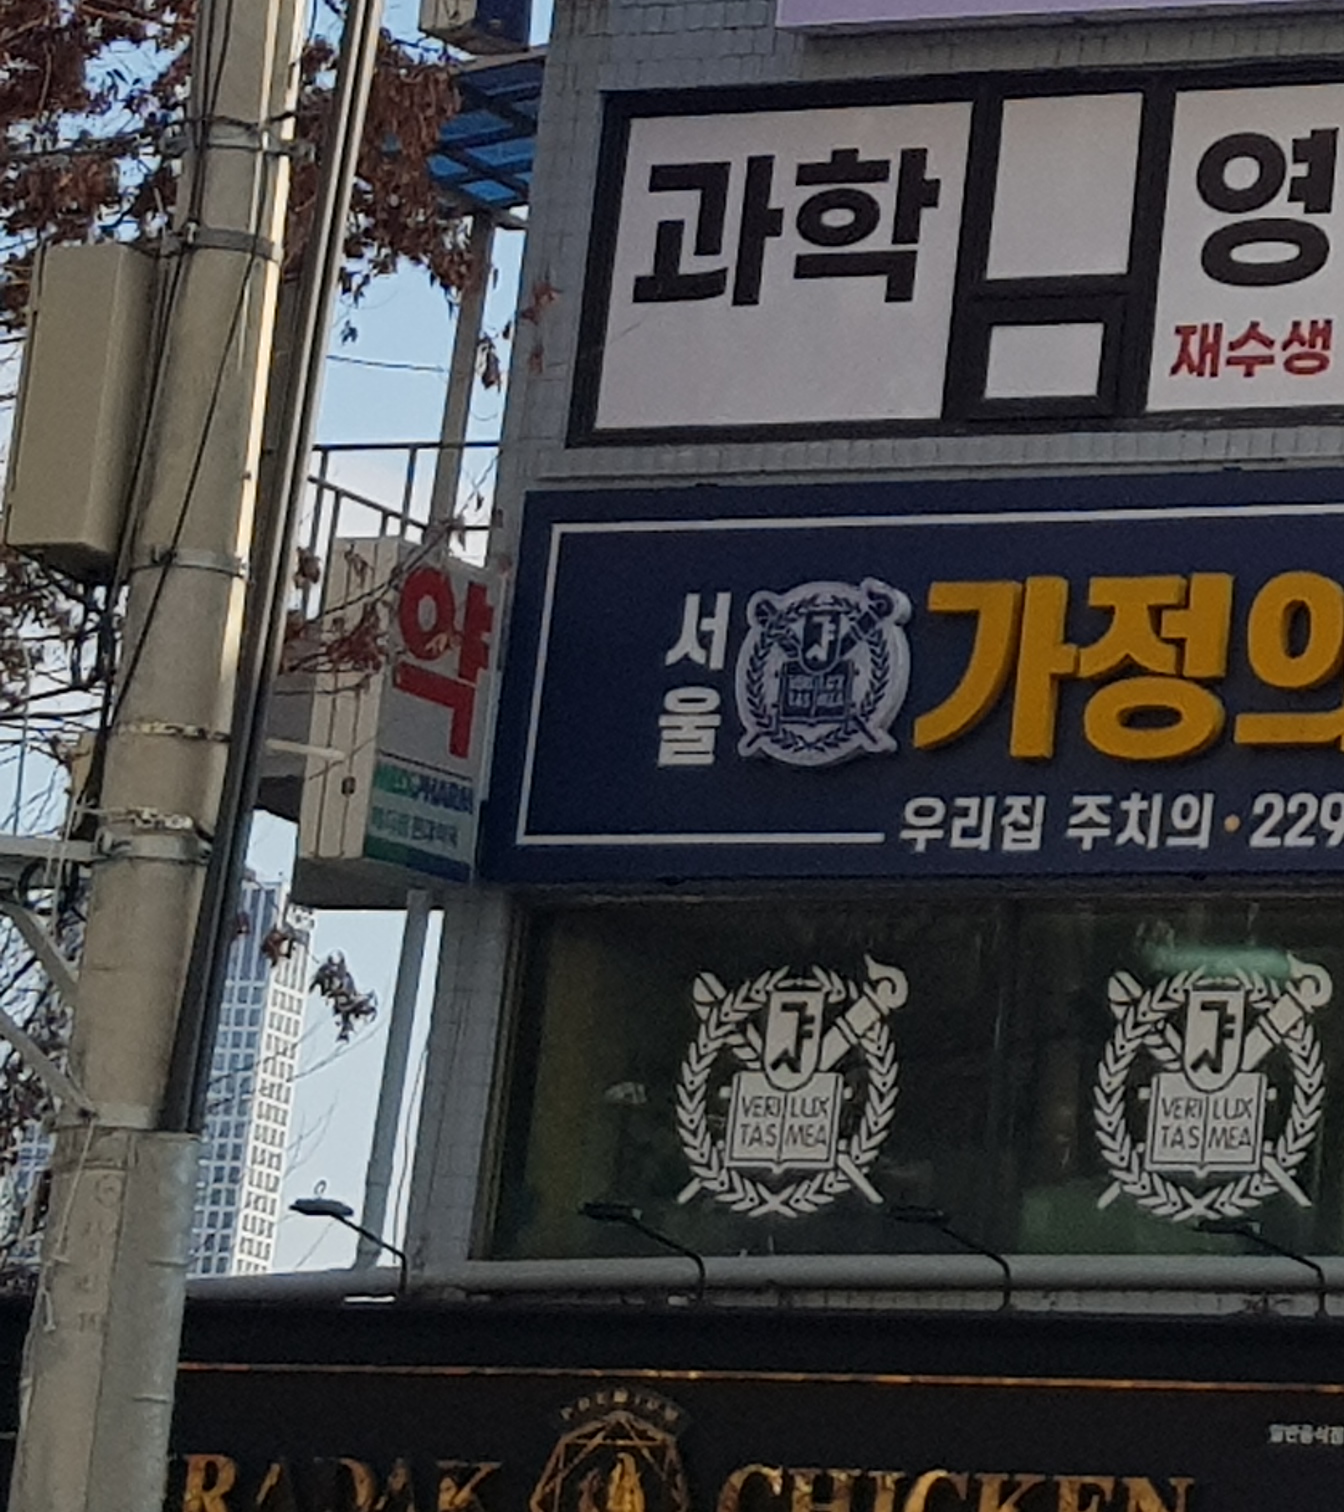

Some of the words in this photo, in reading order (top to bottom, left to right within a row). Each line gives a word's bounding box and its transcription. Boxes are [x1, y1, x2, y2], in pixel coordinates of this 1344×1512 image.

[633, 147, 941, 307] 과학
[1169, 317, 1335, 379] 재수생
[393, 566, 496, 760] 약
[899, 795, 1046, 852] 우리집
[716, 1464, 1196, 1512] CHICKEN
